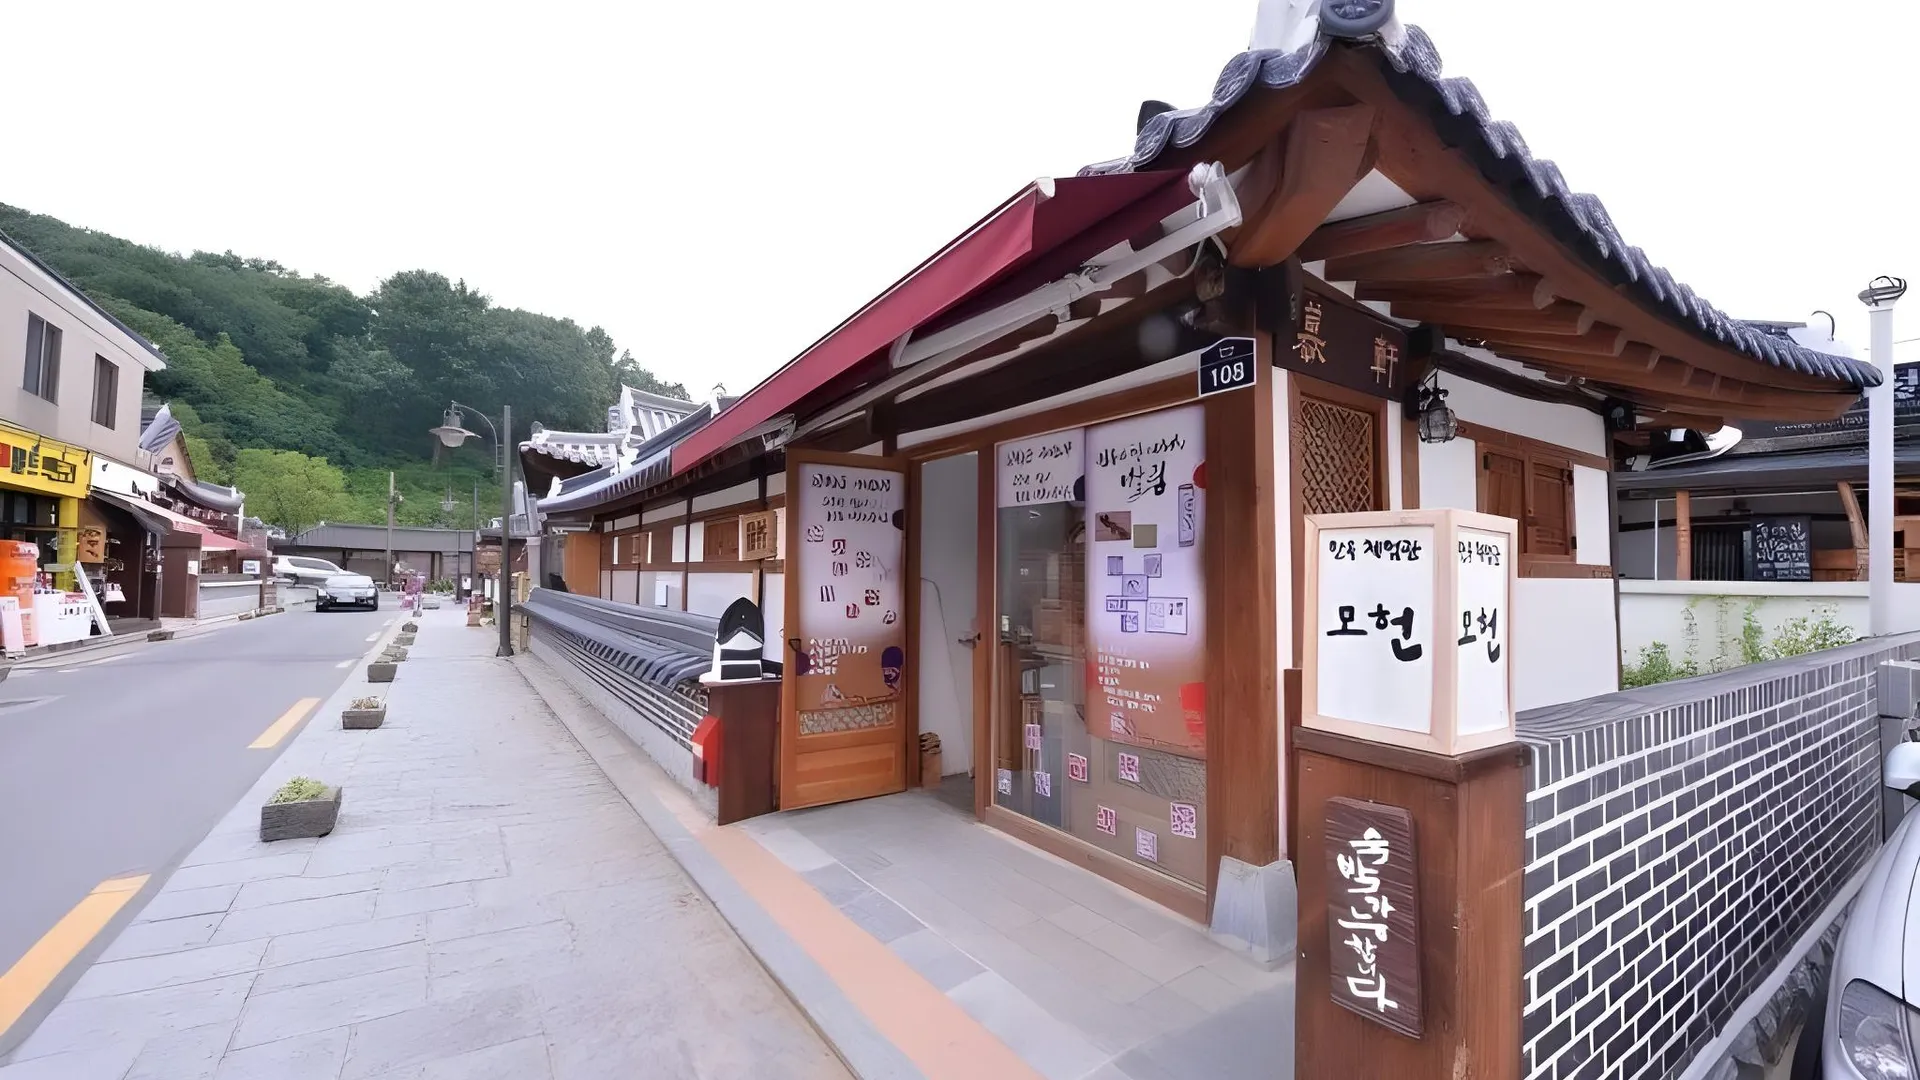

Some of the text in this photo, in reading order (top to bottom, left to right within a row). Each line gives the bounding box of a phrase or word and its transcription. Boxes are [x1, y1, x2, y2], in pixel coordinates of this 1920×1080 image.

[1211, 361, 1245, 387] 108
[1326, 603, 1423, 662] 모헌
[1457, 606, 1501, 664] 모헌
